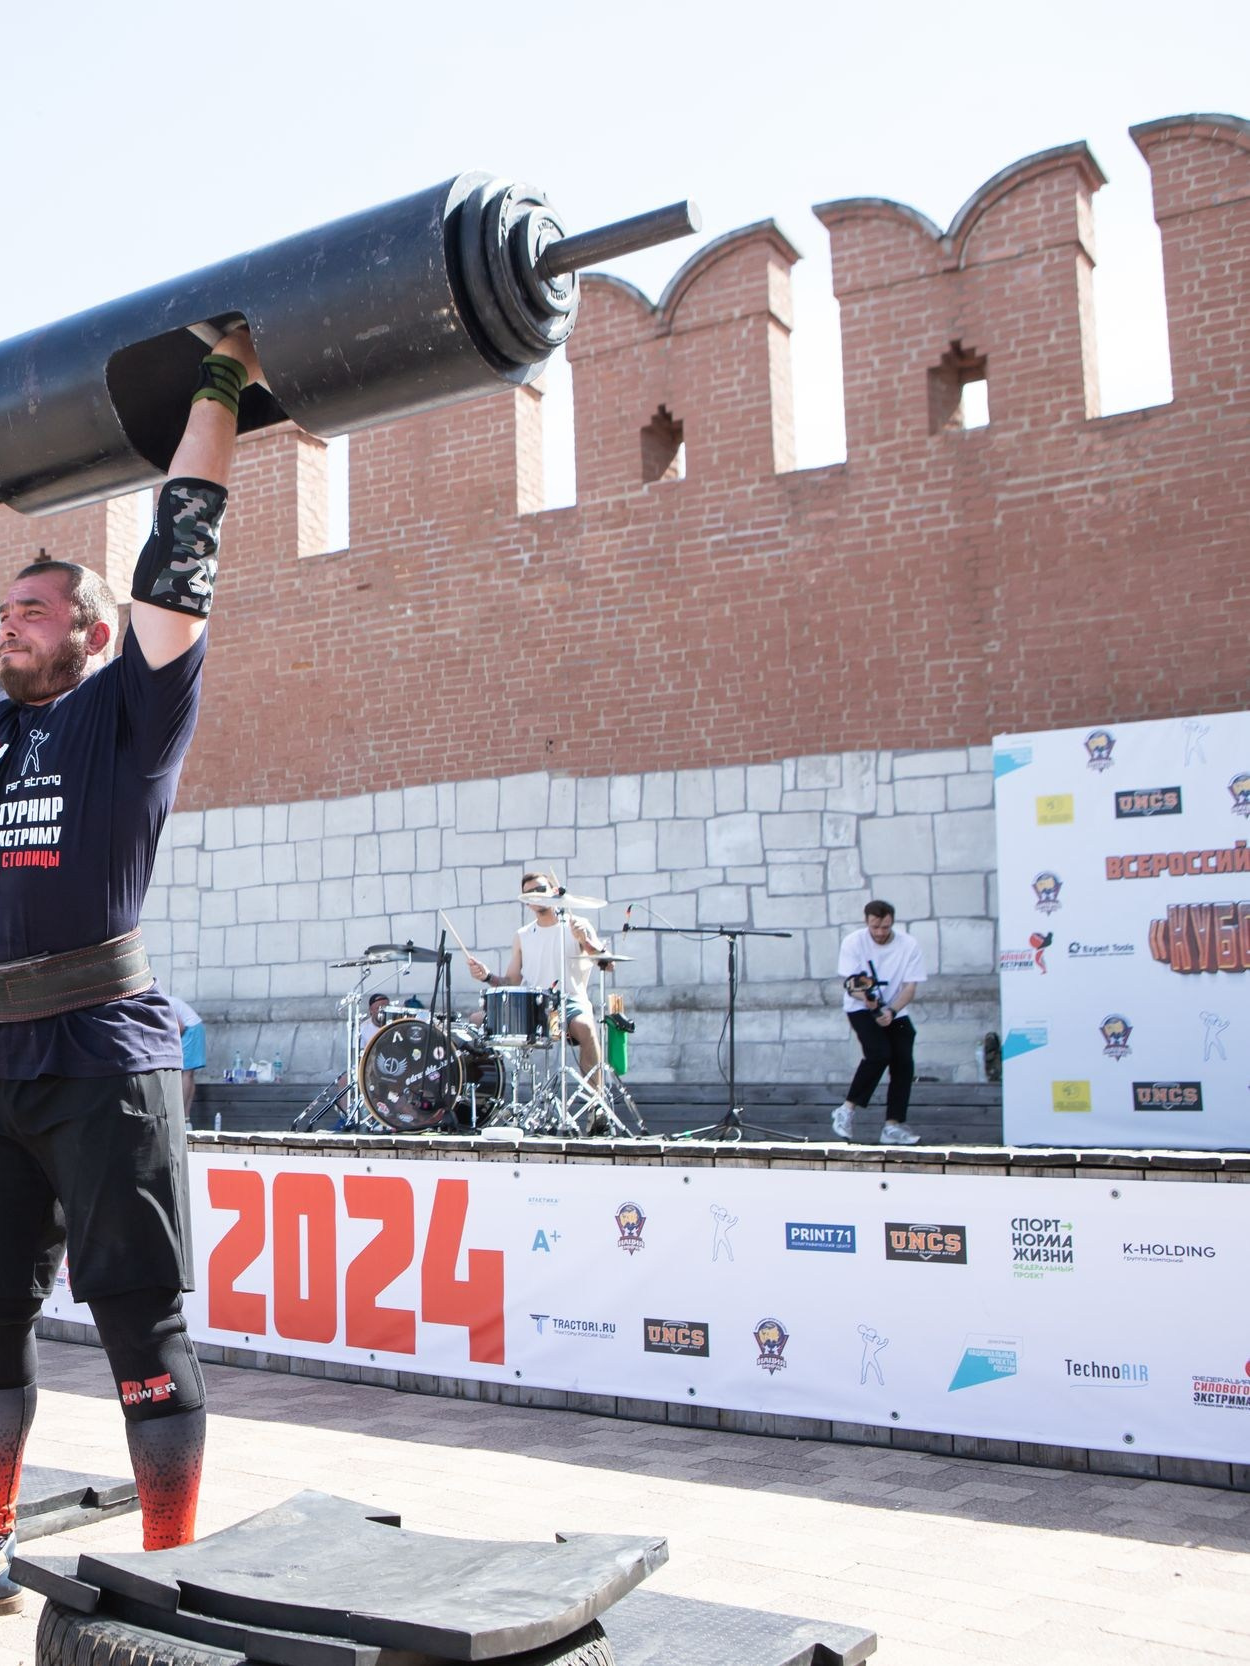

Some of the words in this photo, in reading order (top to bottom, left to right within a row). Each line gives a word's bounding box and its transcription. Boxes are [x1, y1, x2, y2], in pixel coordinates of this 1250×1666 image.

[24, 774, 61, 788] strong
[2, 851, 60, 869] СТОЛИЦЫ
[1136, 1087, 1199, 1105] UNCS
[1011, 1217, 1061, 1232] СПОРТ
[791, 1227, 834, 1242] PRINT
[836, 1230, 851, 1243] 71
[890, 1231, 961, 1252] UNCS
[1012, 1233, 1073, 1248] НОРМА
[1013, 1248, 1074, 1263] ЖИЗНИ
[1123, 1243, 1217, 1258] K-HOLDING
[208, 1168, 505, 1365] 2024
[552, 1318, 616, 1334] TRACTORI.RU
[648, 1326, 705, 1346] UNCS
[1065, 1359, 1149, 1381] TechnoAIR
[122, 1382, 177, 1403] POWER
[1194, 1381, 1250, 1395] СИЛОВОГО
[1193, 1392, 1250, 1406] ЭКСТРИМА
